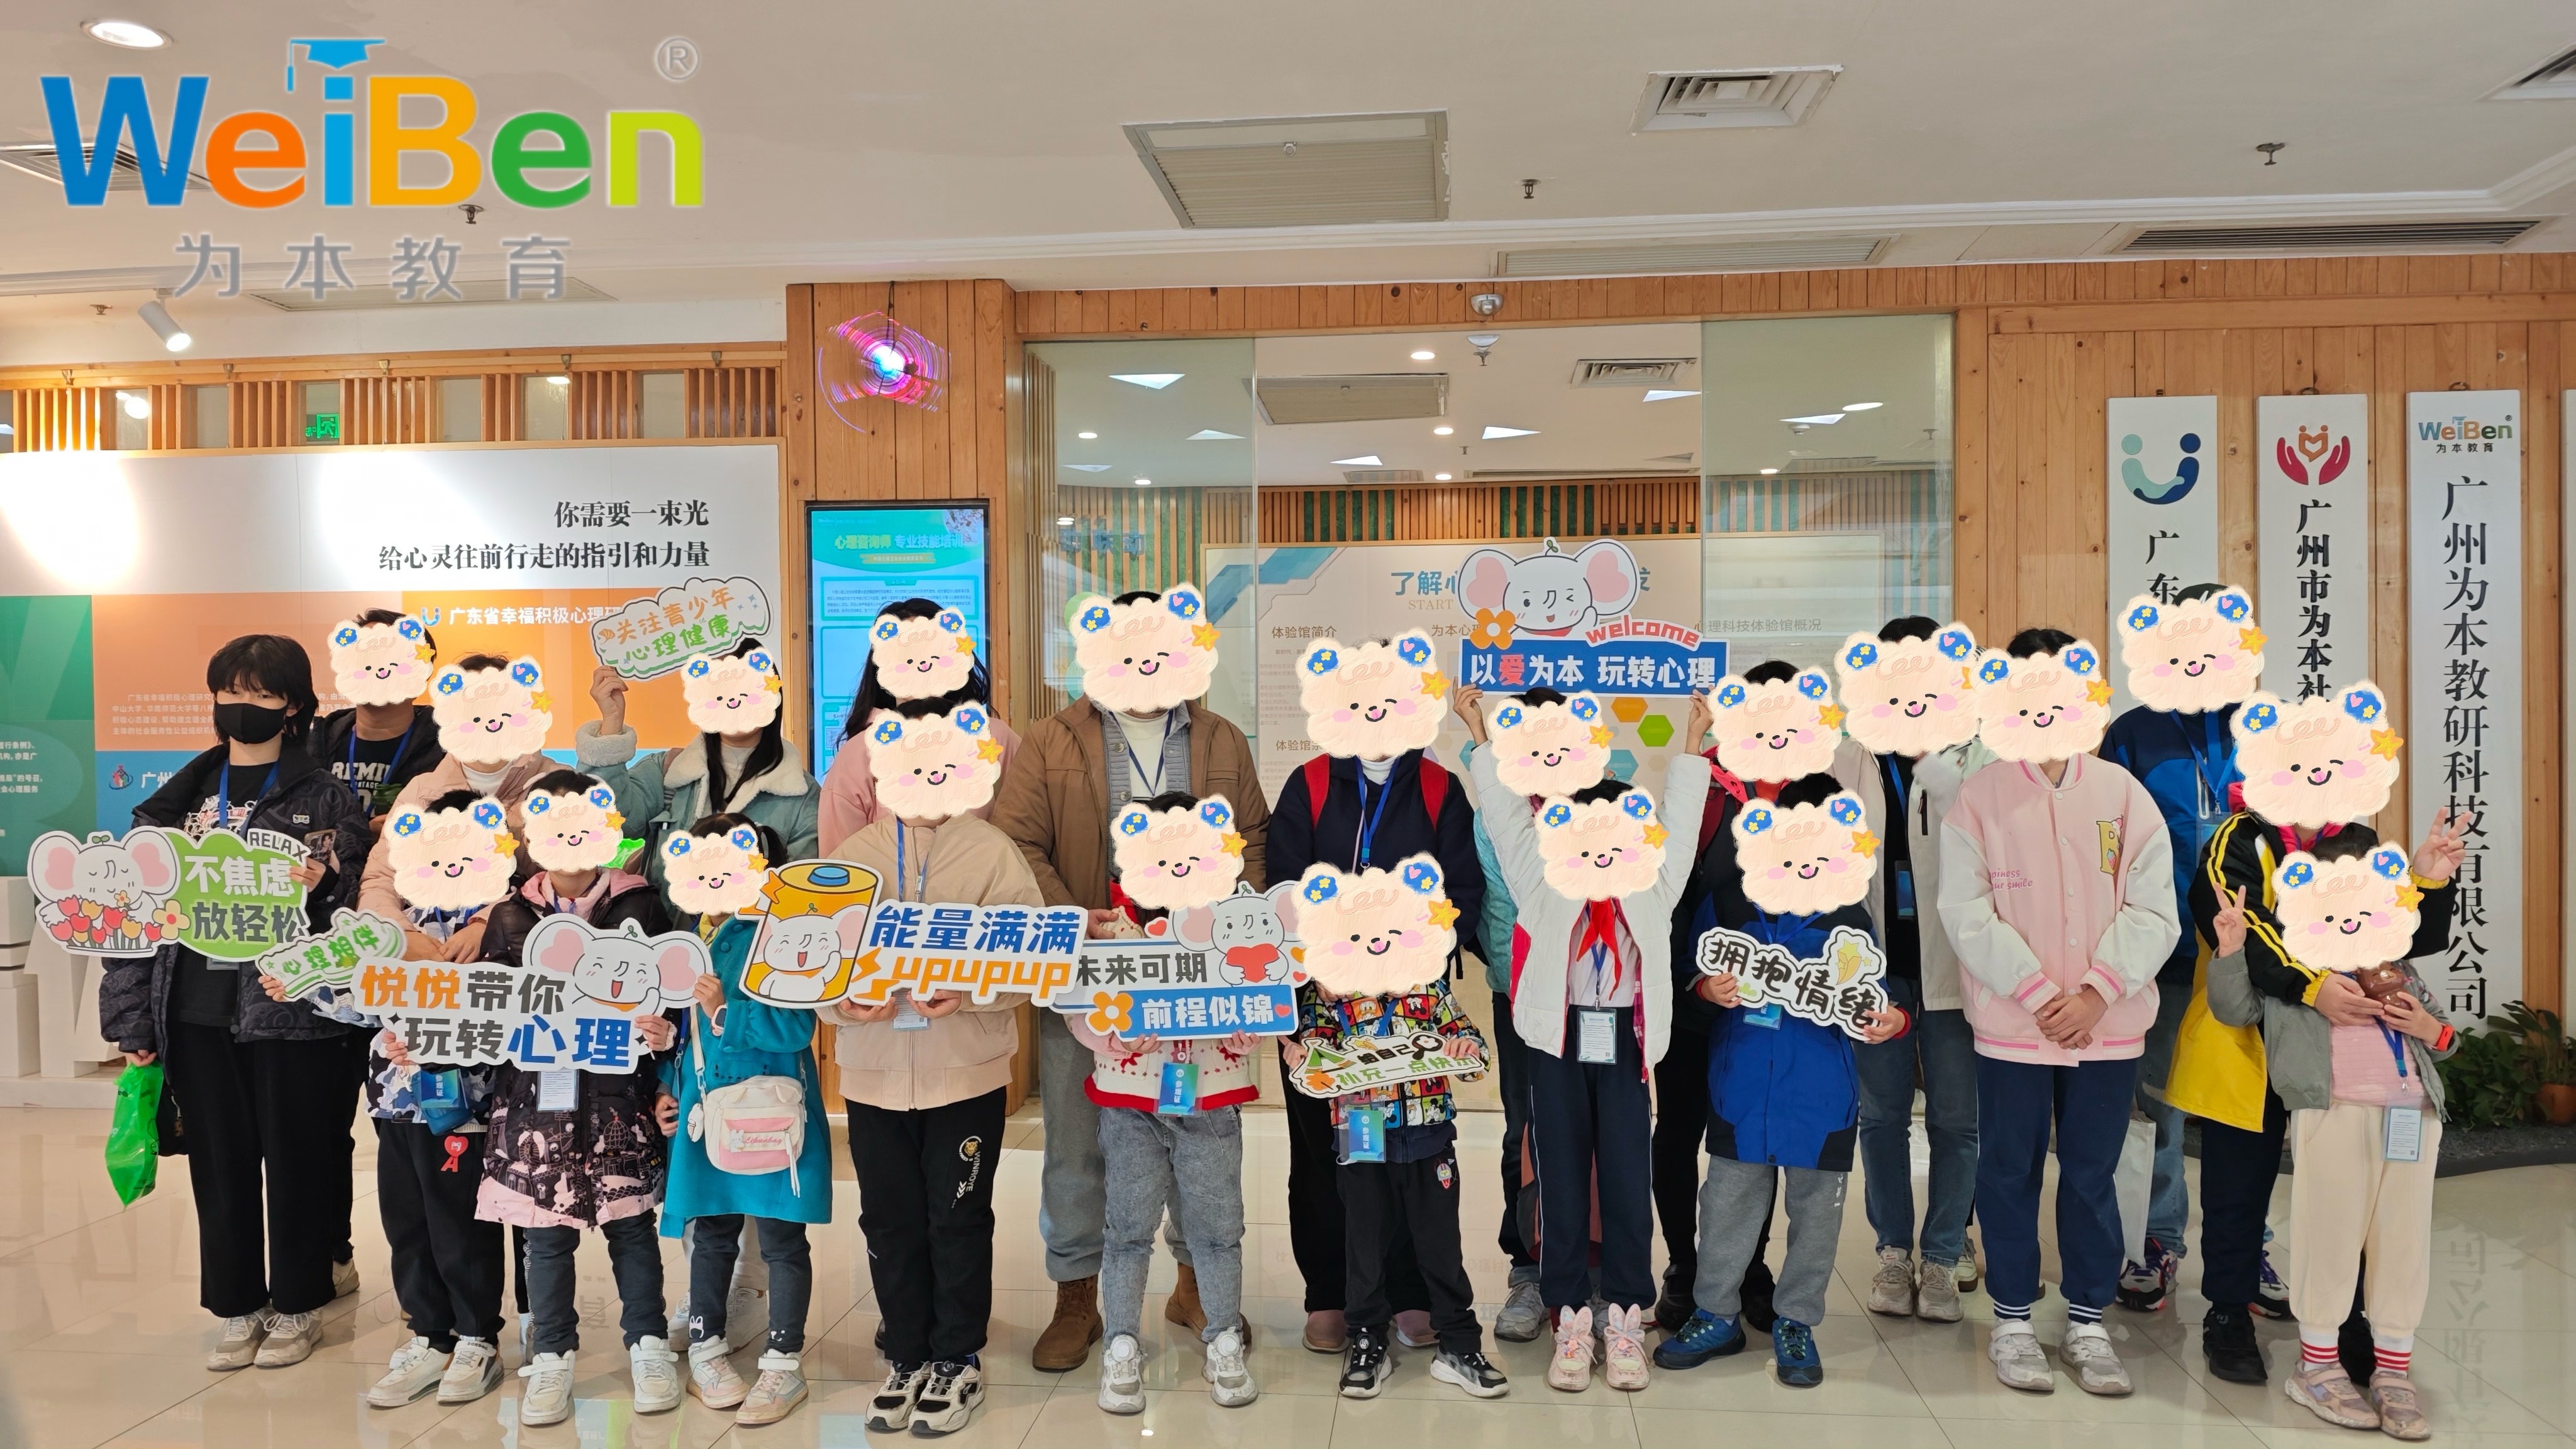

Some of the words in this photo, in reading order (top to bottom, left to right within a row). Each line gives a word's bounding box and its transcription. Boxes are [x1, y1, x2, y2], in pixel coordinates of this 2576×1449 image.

[2418, 420, 2512, 440] WeiBen
[2436, 442, 2494, 453] 为本教育
[554, 499, 709, 528] 你需要一束光
[379, 541, 710, 570] 给心灵往前行走的指引和力量
[835, 535, 892, 550] 心理咨询师
[894, 534, 963, 549] 专业技能培训
[2145, 530, 2180, 604] 广东
[614, 587, 735, 645] 关注青少年
[1408, 599, 1454, 610] START
[2296, 499, 2333, 702] 广州市为本社
[626, 614, 731, 660] 心理健康
[1271, 626, 1337, 639] 体验馆简介
[1585, 614, 1700, 648] welcome
[1470, 654, 1584, 687] 以爱为本
[1597, 656, 1716, 688] 玩转心理
[2441, 476, 2490, 1020] 广州为本教研科技有限公司
[250, 831, 308, 863] RELAX
[184, 855, 294, 897] 不焦虑
[2007, 877, 2033, 890] smile
[192, 901, 308, 943] 放轻松
[869, 904, 1080, 955] 能量满满
[891, 956, 1072, 999] upupup
[1076, 953, 1208, 986] 未来可期
[1708, 938, 1877, 1030] 拥抱情绪
[360, 965, 566, 1014] 悦悦带你
[1141, 994, 1274, 1030] 前程似锦
[402, 1014, 632, 1067] 玩转心理
[1357, 1043, 1416, 1065] 给自己
